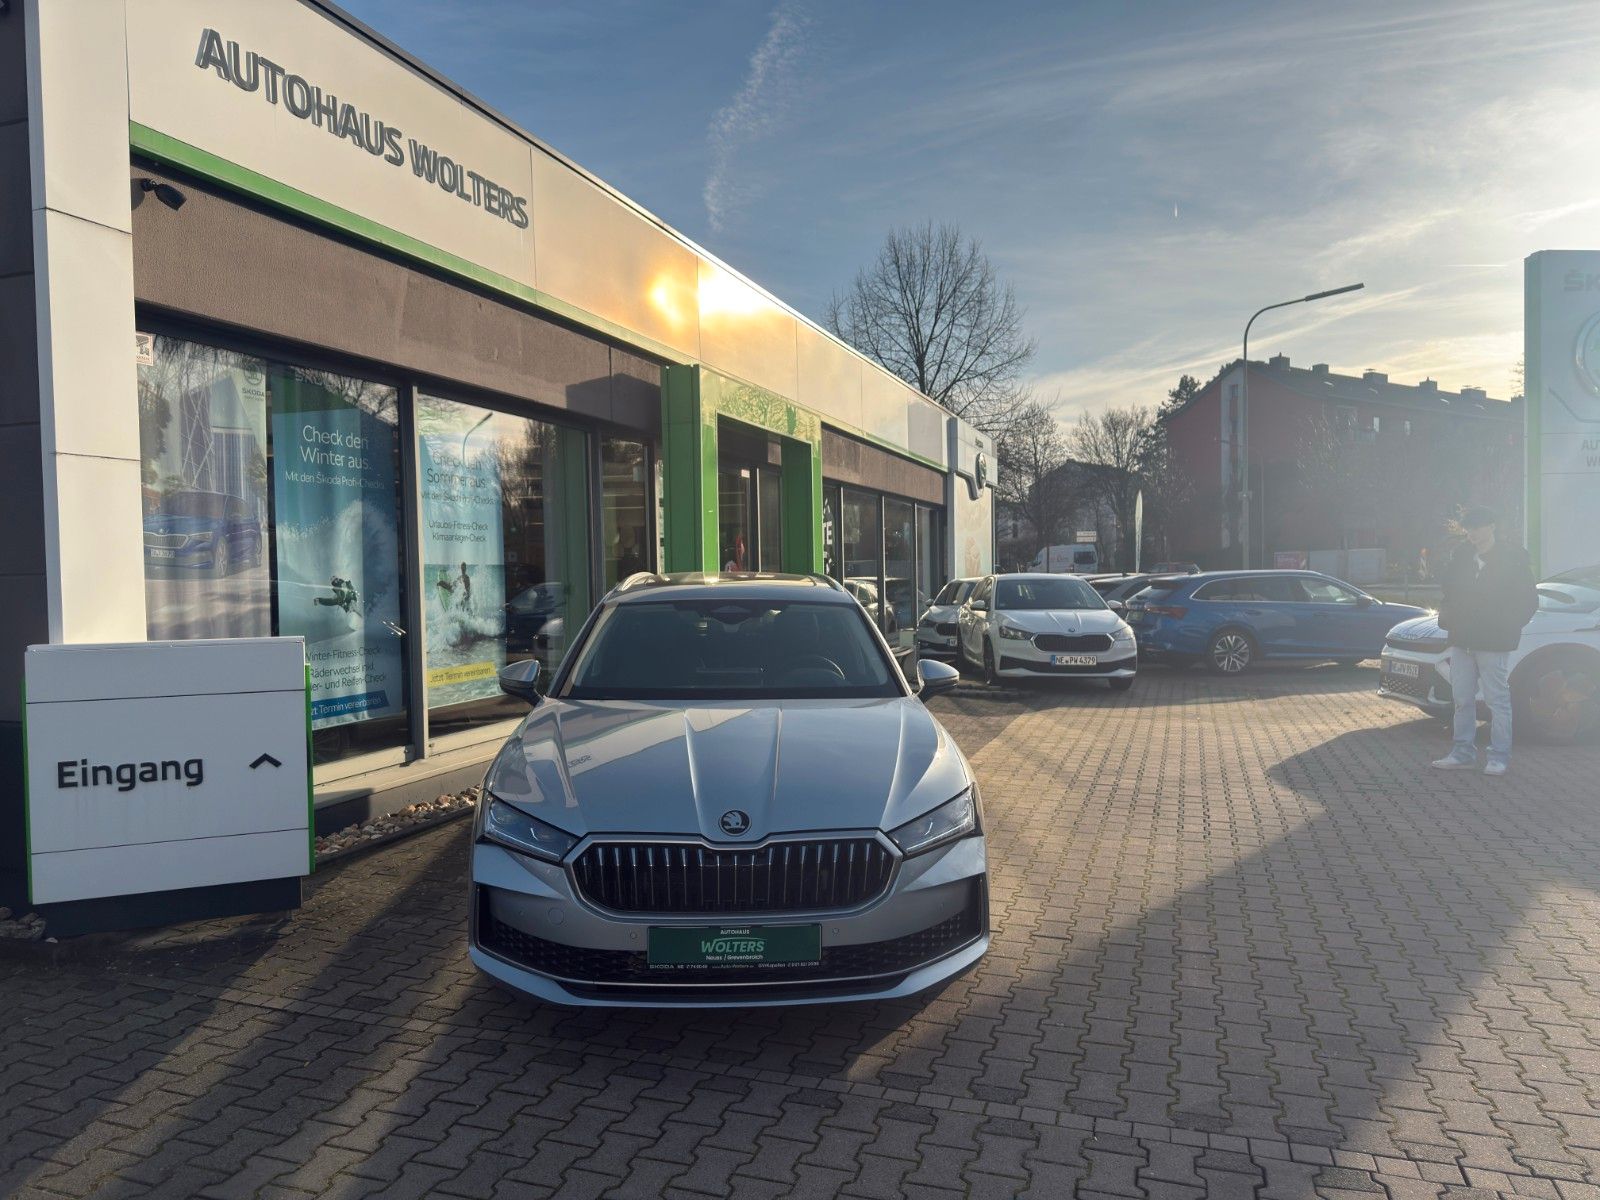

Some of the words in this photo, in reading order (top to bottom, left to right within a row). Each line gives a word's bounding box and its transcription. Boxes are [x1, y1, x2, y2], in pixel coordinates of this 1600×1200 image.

[195, 28, 404, 166] AUTOHAUS
[408, 139, 528, 229] WOLTERS
[303, 425, 343, 447] Check
[346, 432, 369, 450] den
[300, 446, 345, 467] Winter
[348, 456, 373, 471] aus.
[285, 471, 299, 482] Mit
[301, 473, 315, 483] den
[325, 679, 340, 690] und
[319, 701, 344, 715] Termin
[57, 759, 204, 791] Eingang
[701, 940, 765, 953] WOLTERS
